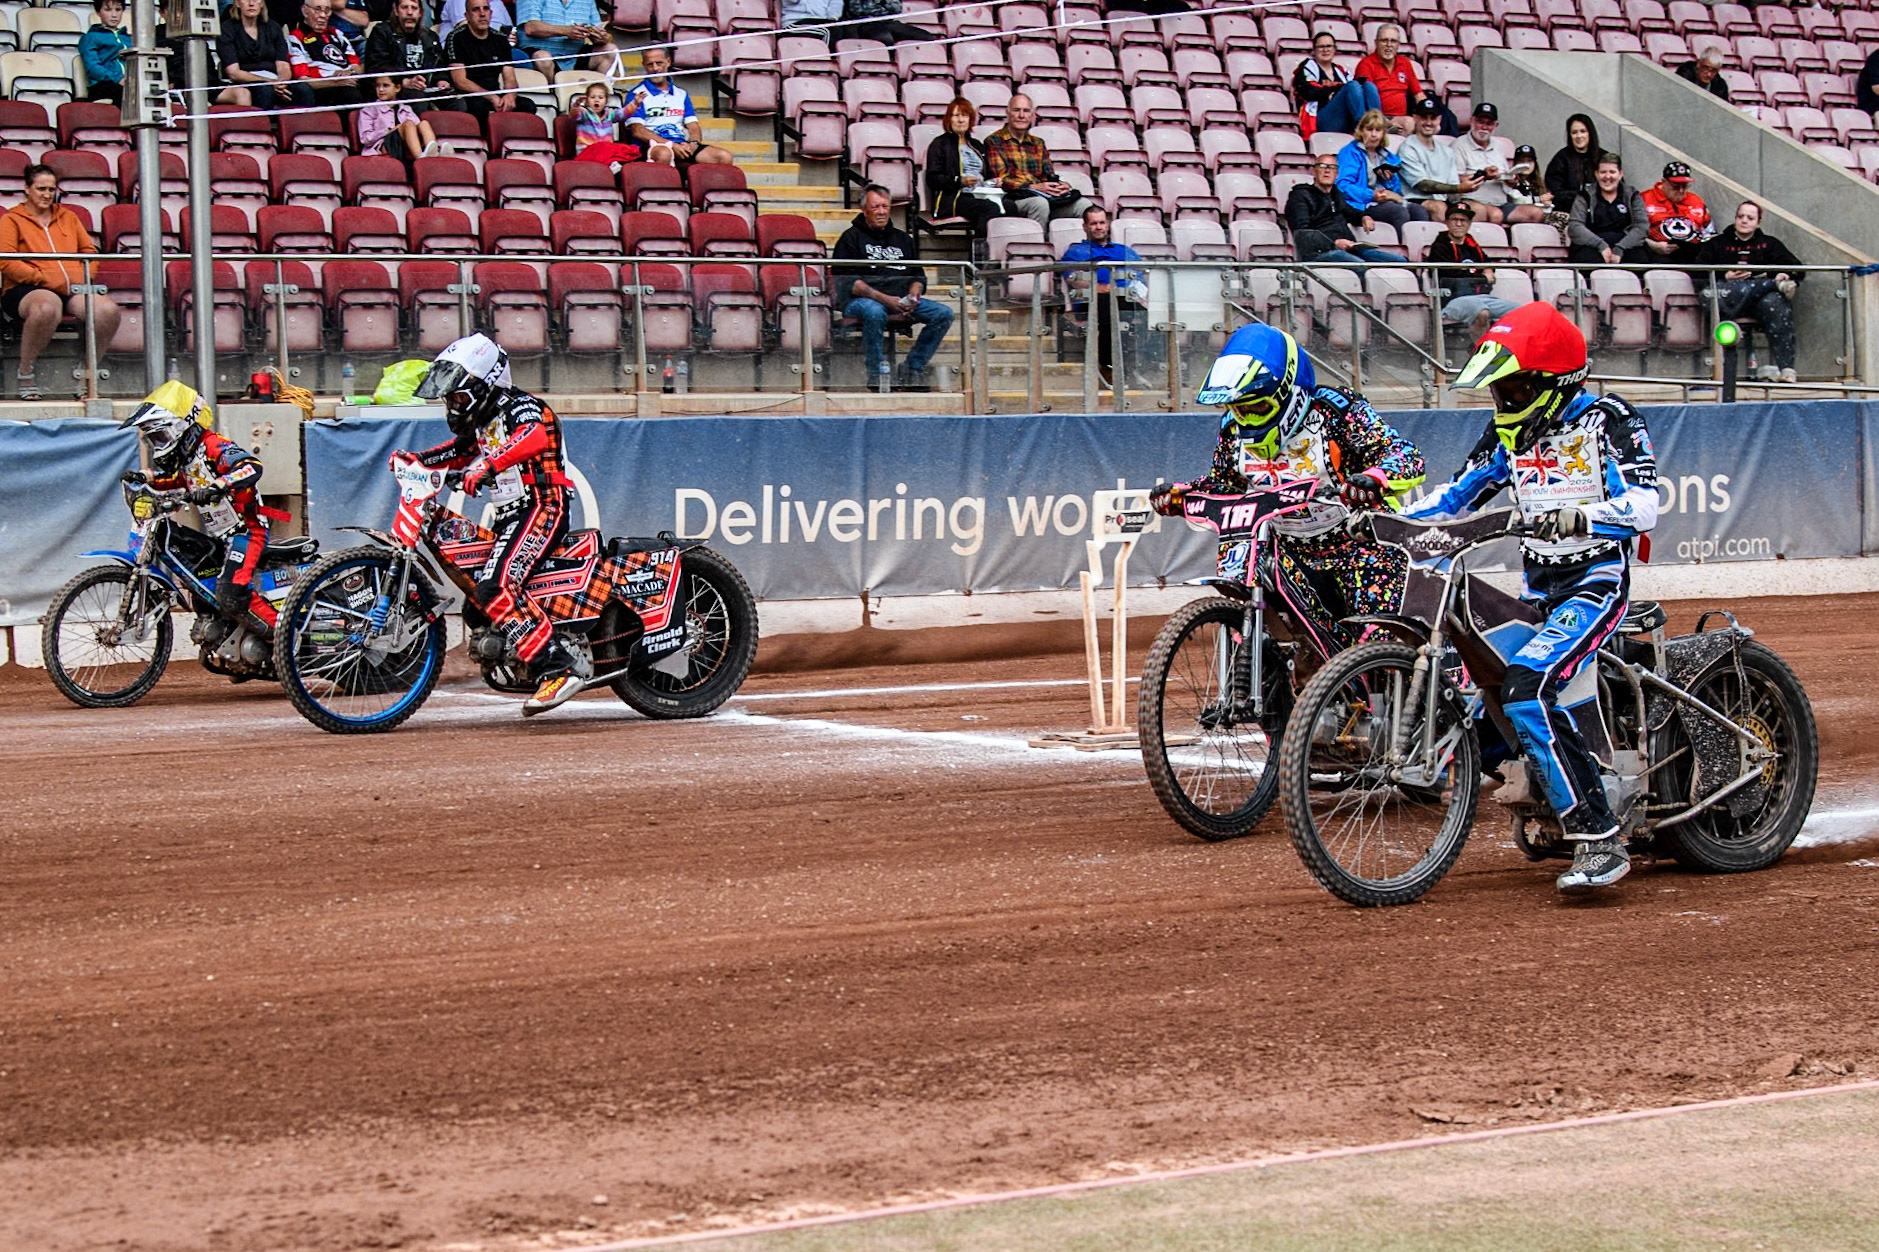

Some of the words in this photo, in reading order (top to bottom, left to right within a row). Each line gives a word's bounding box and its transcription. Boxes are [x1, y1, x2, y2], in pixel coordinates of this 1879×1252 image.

[1544, 392, 1564, 420] THOR
[674, 482, 986, 557] Delivering
[650, 549, 675, 566] 914
[1676, 534, 1771, 564] atpi.com
[620, 580, 665, 595] MACADE
[641, 626, 684, 646] Arnold
[647, 637, 681, 654] Clark
